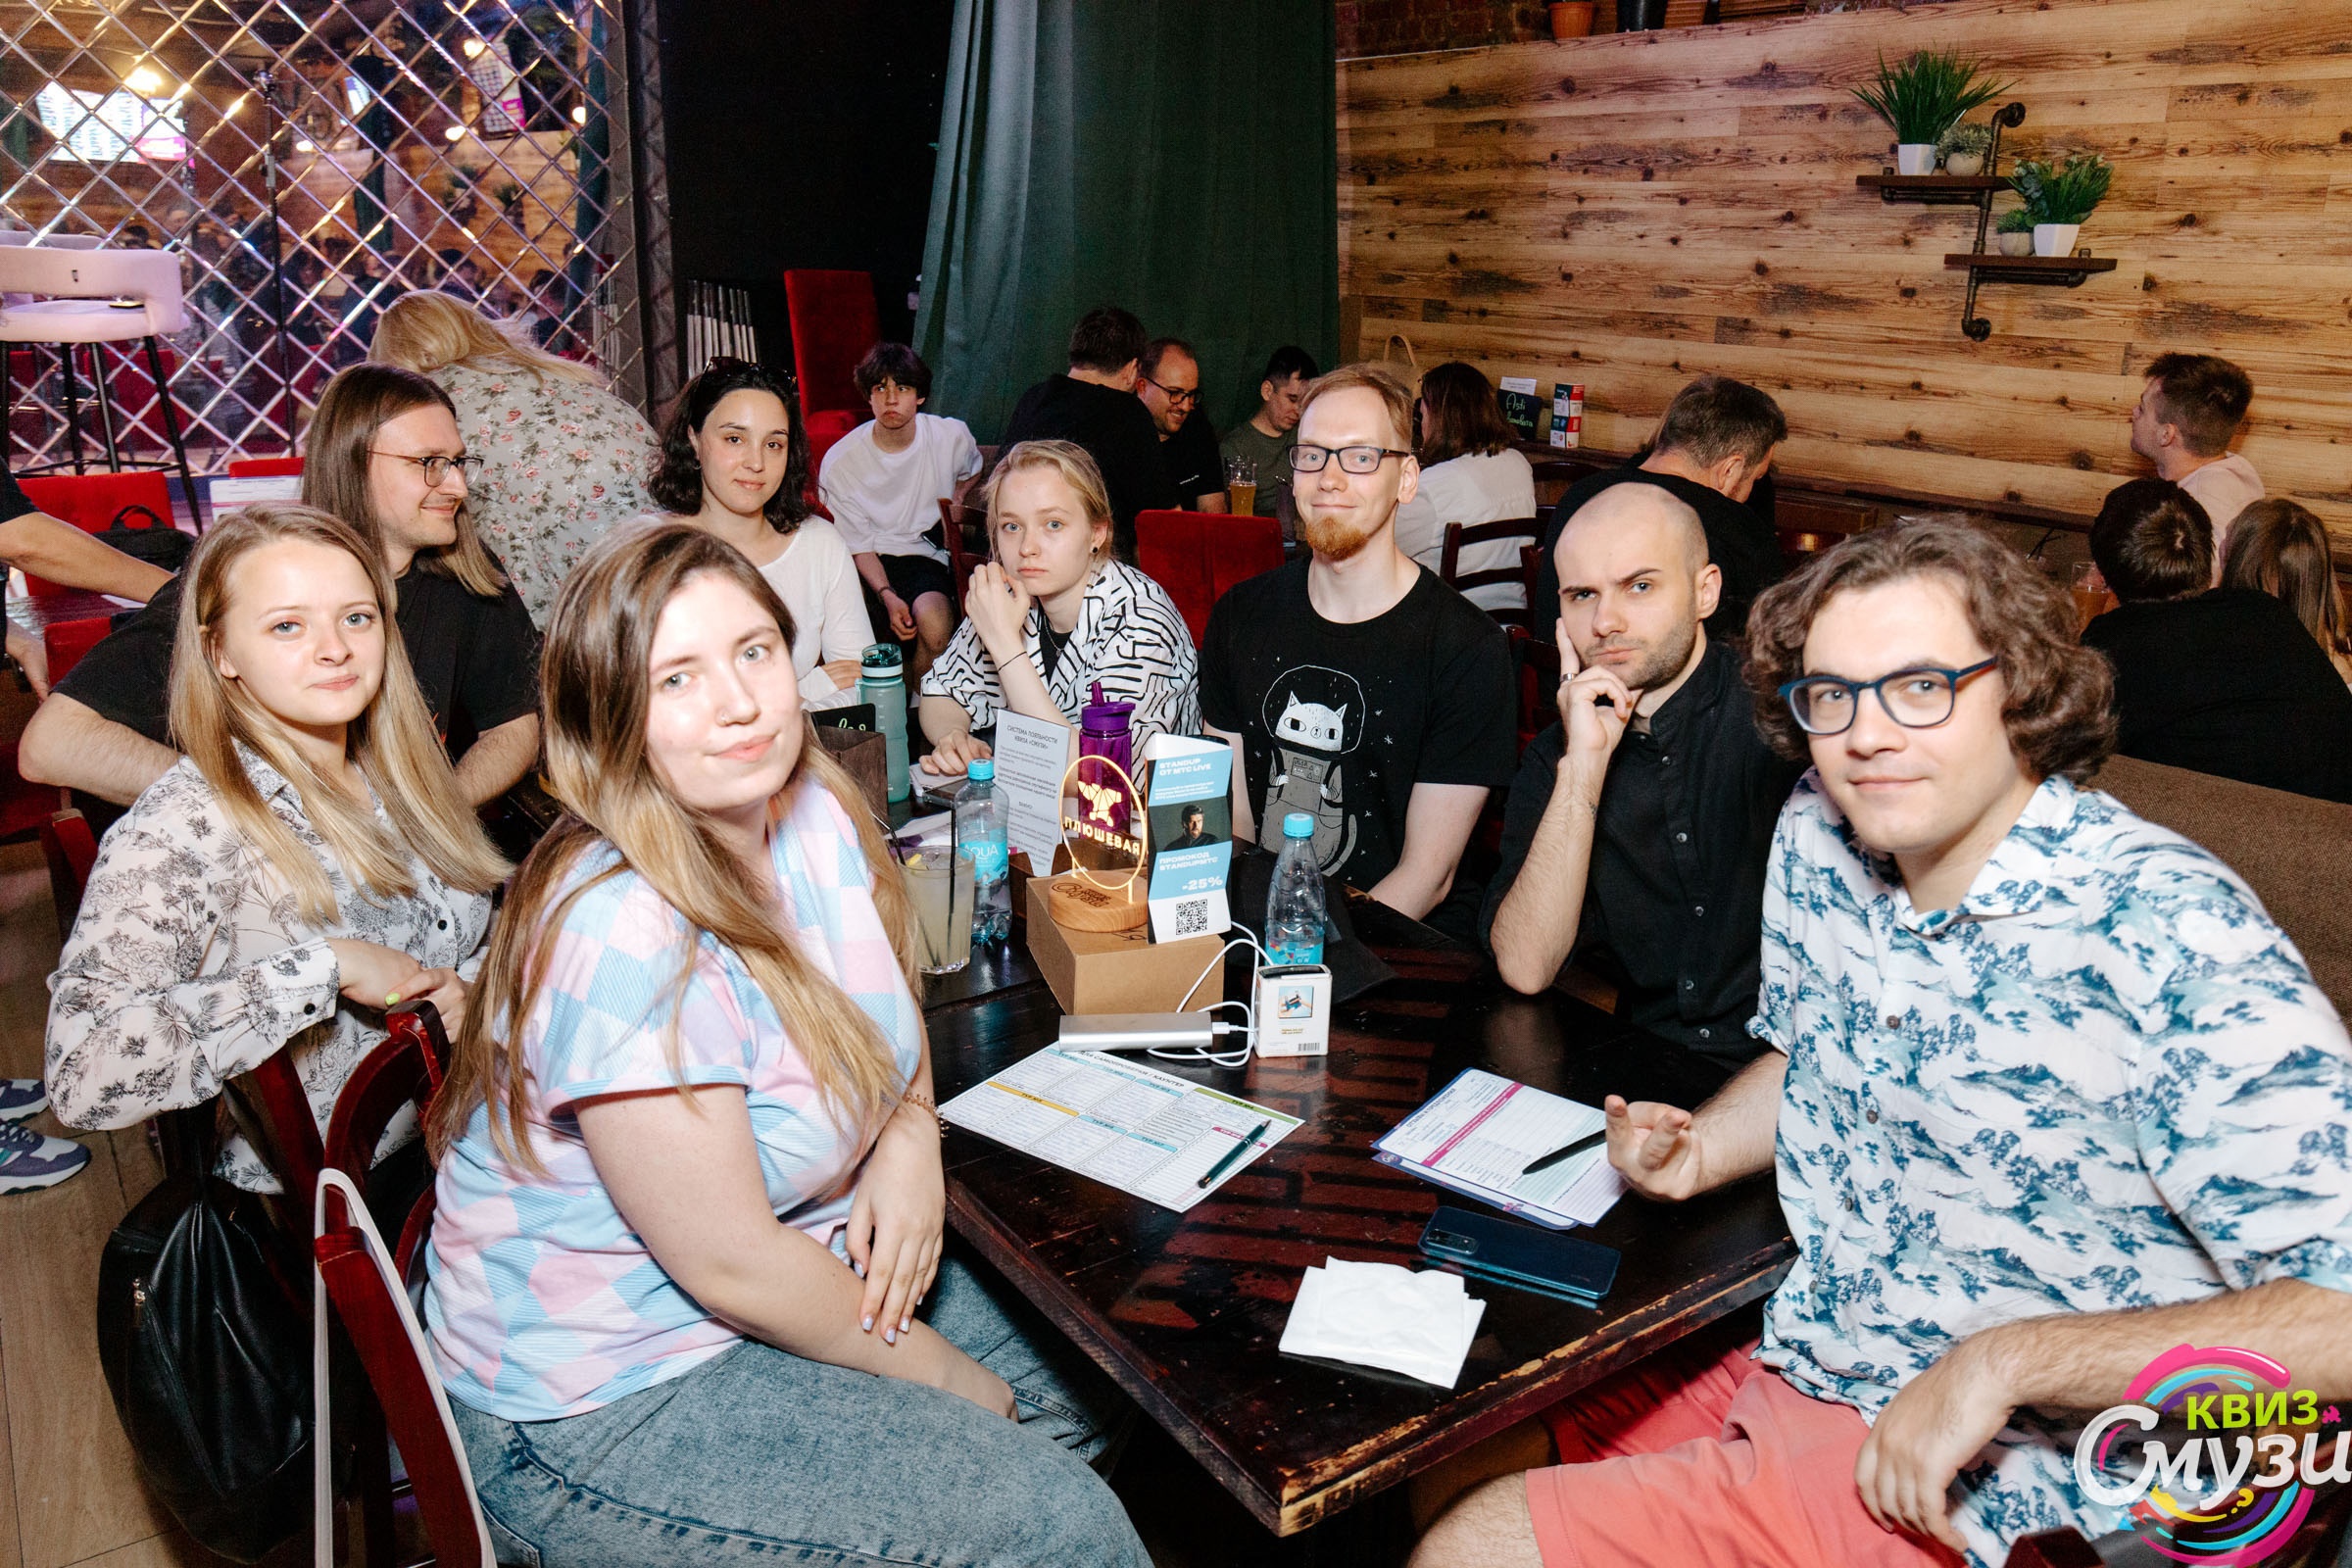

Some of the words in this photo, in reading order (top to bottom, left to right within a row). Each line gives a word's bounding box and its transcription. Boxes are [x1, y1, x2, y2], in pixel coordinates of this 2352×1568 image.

[1006, 725, 1027, 735] СИСТЕМА
[1159, 758, 1201, 769] STANDUP
[1193, 763, 1211, 772] LIVE
[1064, 816, 1141, 856] ПЛЮШЕВАЯ
[1159, 852, 1209, 864] ПРОМОКОД
[1182, 876, 1223, 891] -25%
[1152, 1074, 1185, 1088] КАУНТЕР
